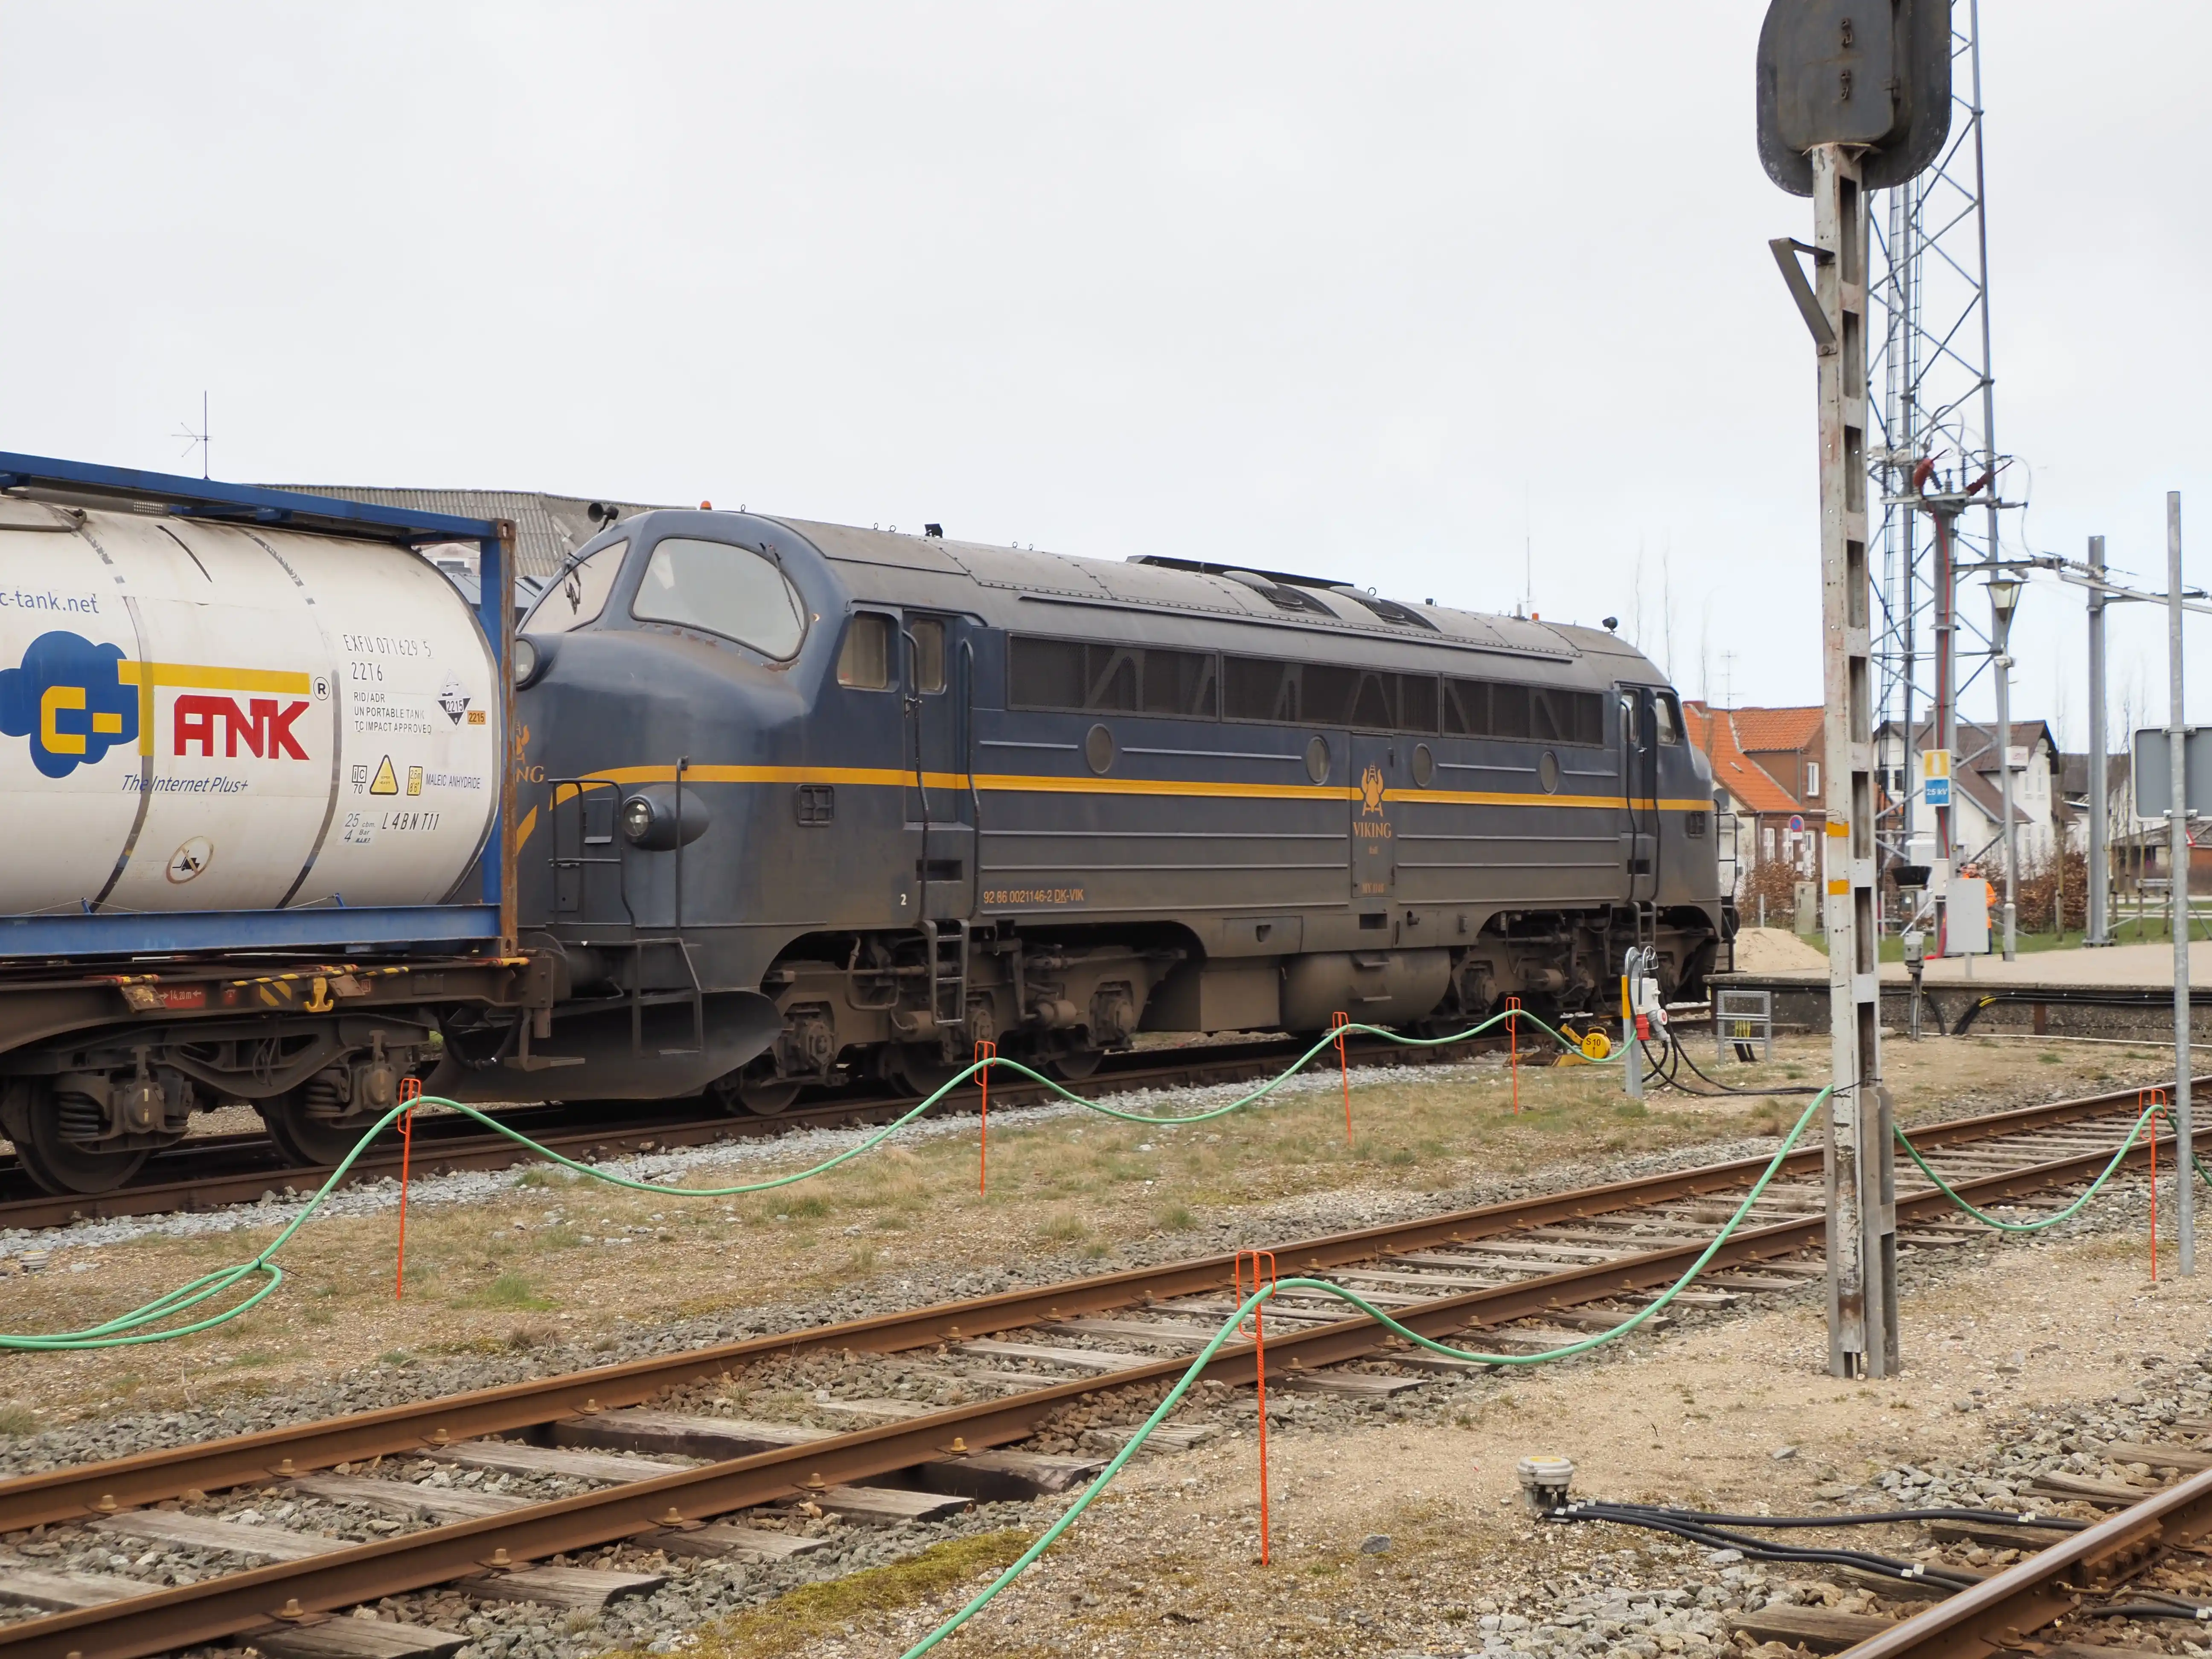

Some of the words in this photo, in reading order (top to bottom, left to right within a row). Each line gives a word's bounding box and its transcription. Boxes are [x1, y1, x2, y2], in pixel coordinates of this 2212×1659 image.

[343, 634, 373, 652] EXFU
[376, 637, 418, 656] 071629
[423, 641, 431, 657] 5
[352, 662, 383, 681] 22T6
[354, 692, 385, 703] RID/ADR
[354, 706, 364, 716] UN
[366, 707, 405, 718] PORTABLE
[406, 709, 425, 719] TANK
[447, 700, 463, 712] 2215
[469, 713, 484, 722] 2215
[355, 721, 364, 732] TC
[366, 721, 392, 732] IMPACT
[393, 723, 432, 734] APPROVED
[122, 774, 148, 791] The
[150, 776, 210, 792] Internet
[209, 776, 248, 793] Plus+
[426, 774, 447, 786] MALEIC
[448, 776, 480, 789] ANHYDRIDE
[354, 784, 363, 794] 70
[345, 813, 361, 827] 25
[344, 829, 353, 842] 4
[1353, 822, 1391, 838] VIKING
[900, 894, 907, 905] 2
[984, 891, 994, 903] 92
[997, 891, 1007, 903] 86
[1010, 889, 1052, 903] 0021146-2
[1054, 889, 1084, 903] DK-VIK
